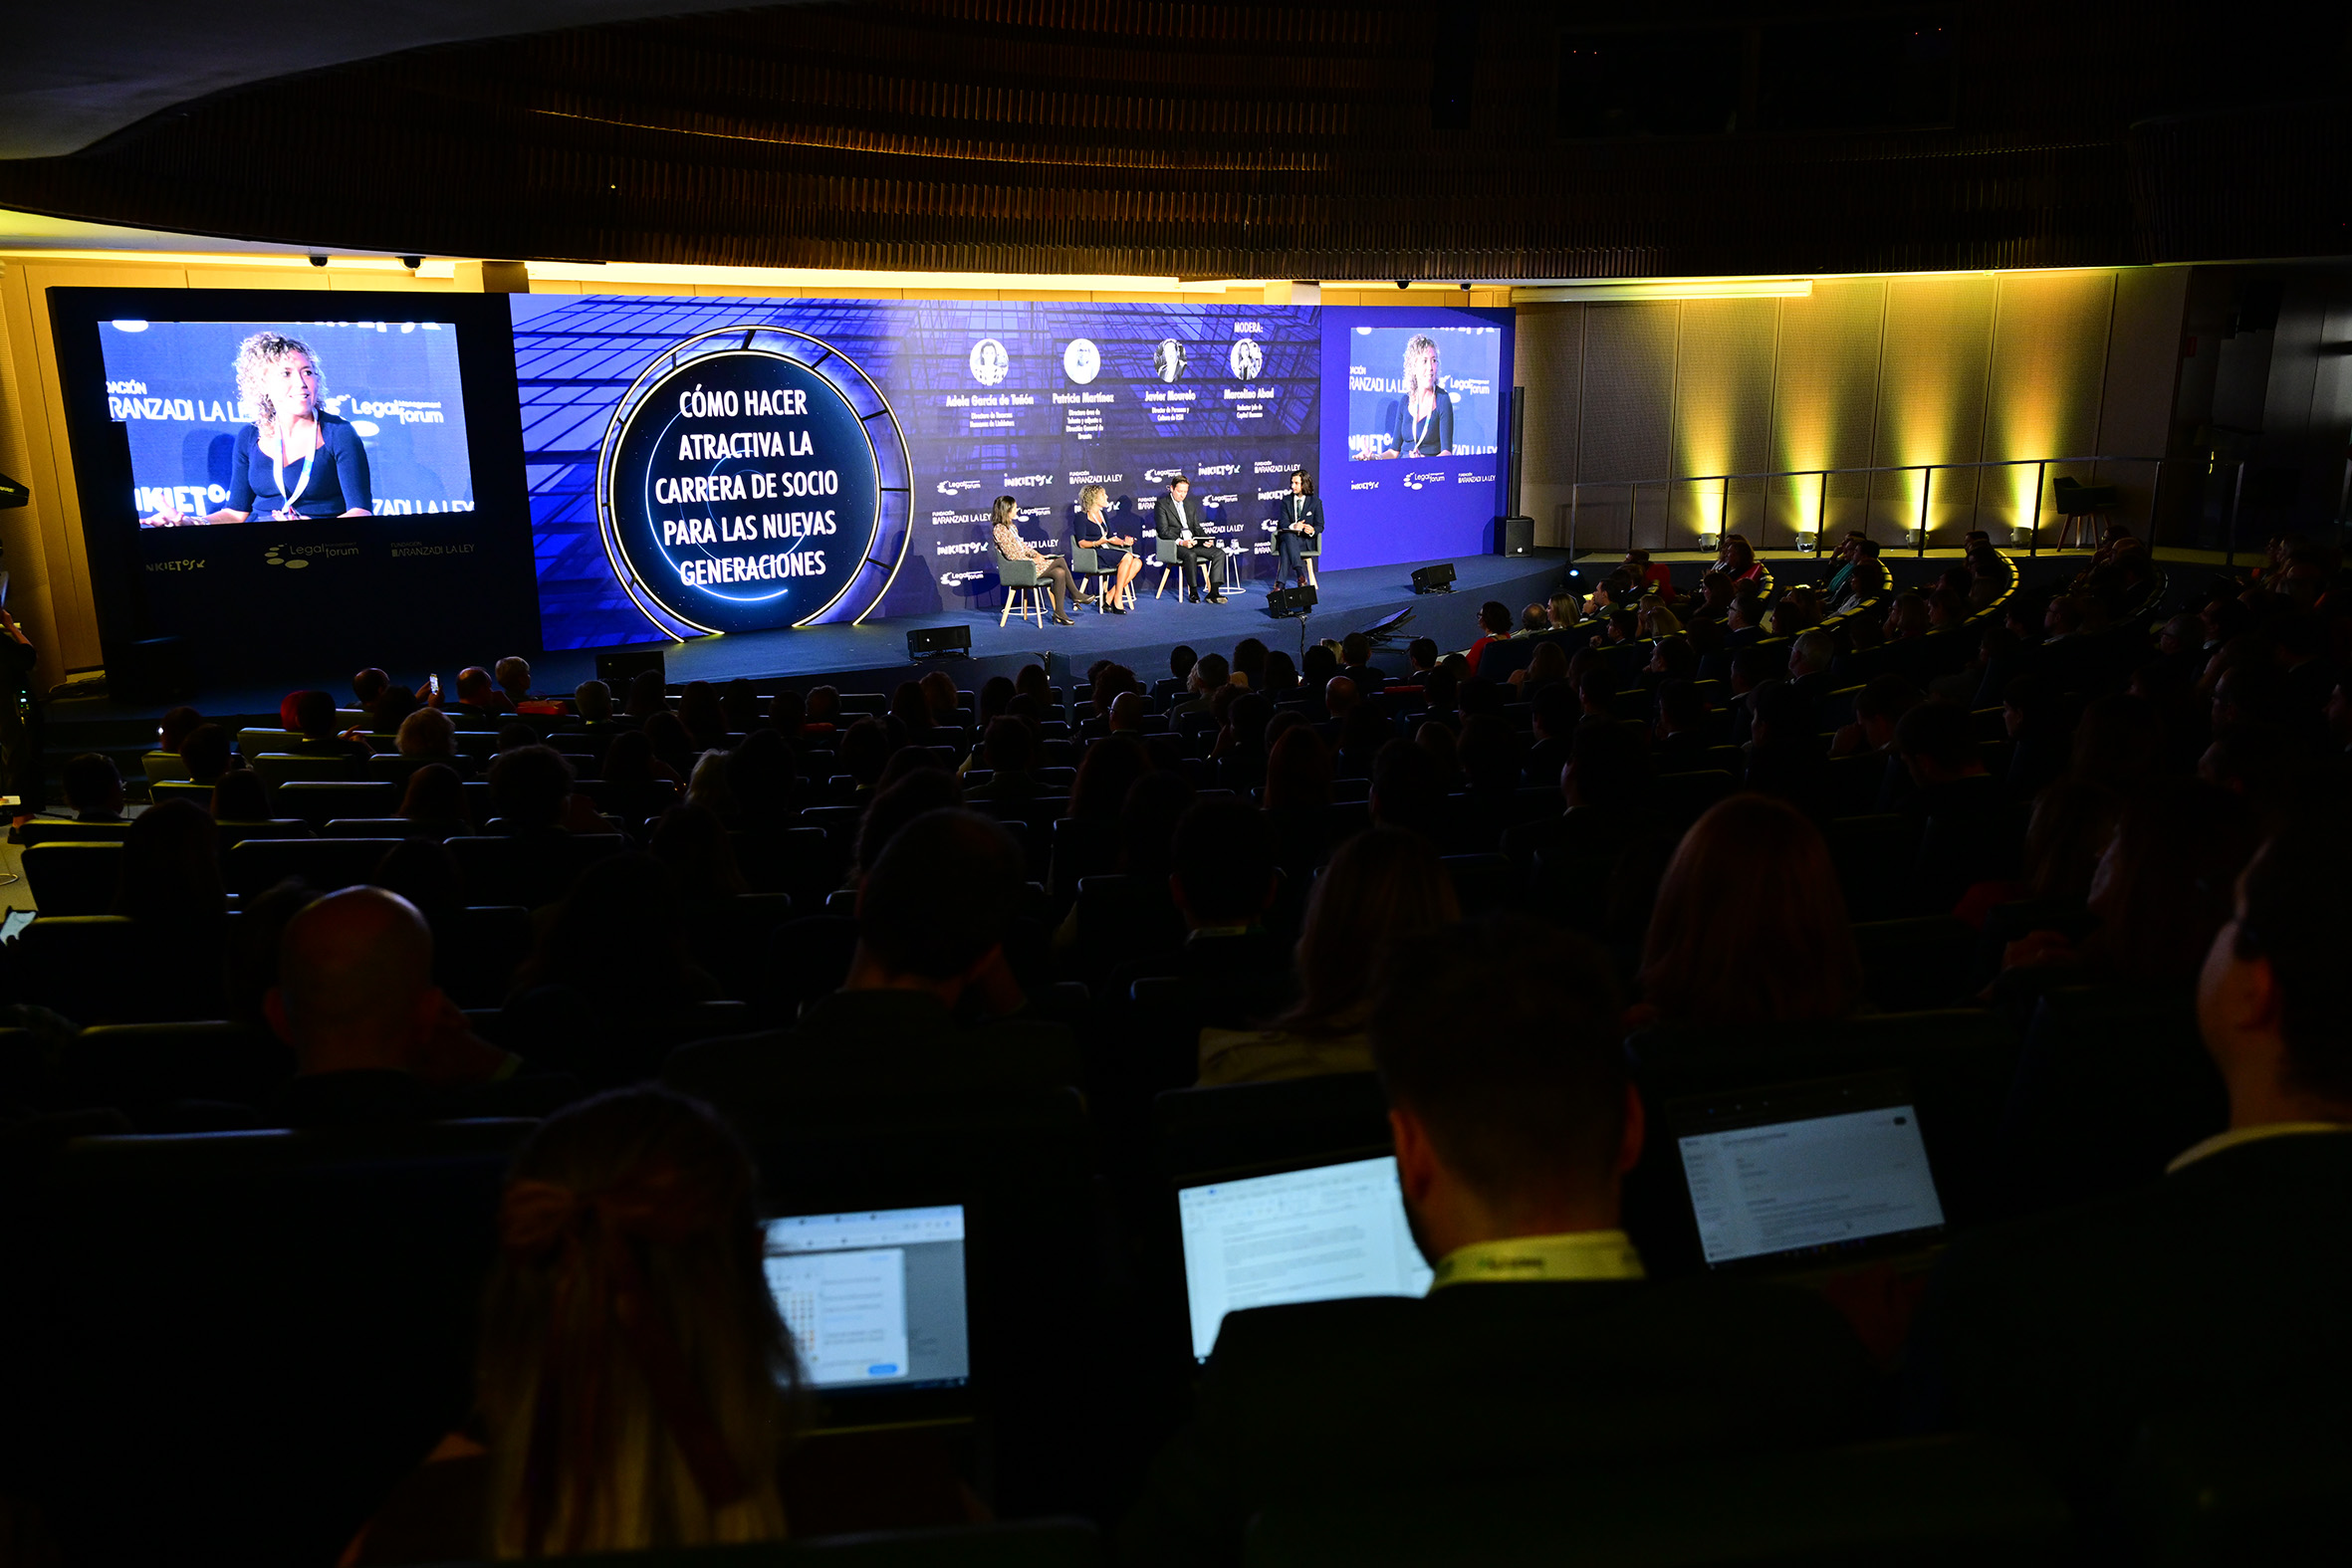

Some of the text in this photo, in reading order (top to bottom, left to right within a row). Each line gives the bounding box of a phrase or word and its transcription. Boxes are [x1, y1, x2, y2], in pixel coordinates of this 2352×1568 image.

[1234, 322, 1263, 333] MODERA:
[1349, 377, 1383, 392] RANZADI
[1386, 378, 1397, 392] LA
[1450, 378, 1470, 391] Legal
[679, 383, 808, 418] CÓMO HACER
[946, 395, 969, 407] Adela
[999, 394, 1009, 406] de
[1053, 393, 1081, 404] Patricia
[1145, 391, 1166, 402] Javier
[108, 397, 253, 422] RANZADI LA LE
[352, 398, 398, 418] Legal
[400, 407, 444, 425] forum
[678, 430, 814, 461] ATRACTIVA LA
[1415, 473, 1430, 481] Legal
[655, 470, 838, 504] CARRERA DE SOCIO
[980, 513, 991, 522] LEY
[663, 510, 836, 546] PARA LAS NUEVAS
[290, 543, 325, 556] Legal
[326, 546, 359, 558] forum
[459, 544, 474, 553] LEY
[680, 551, 826, 586] GENERACIONES
